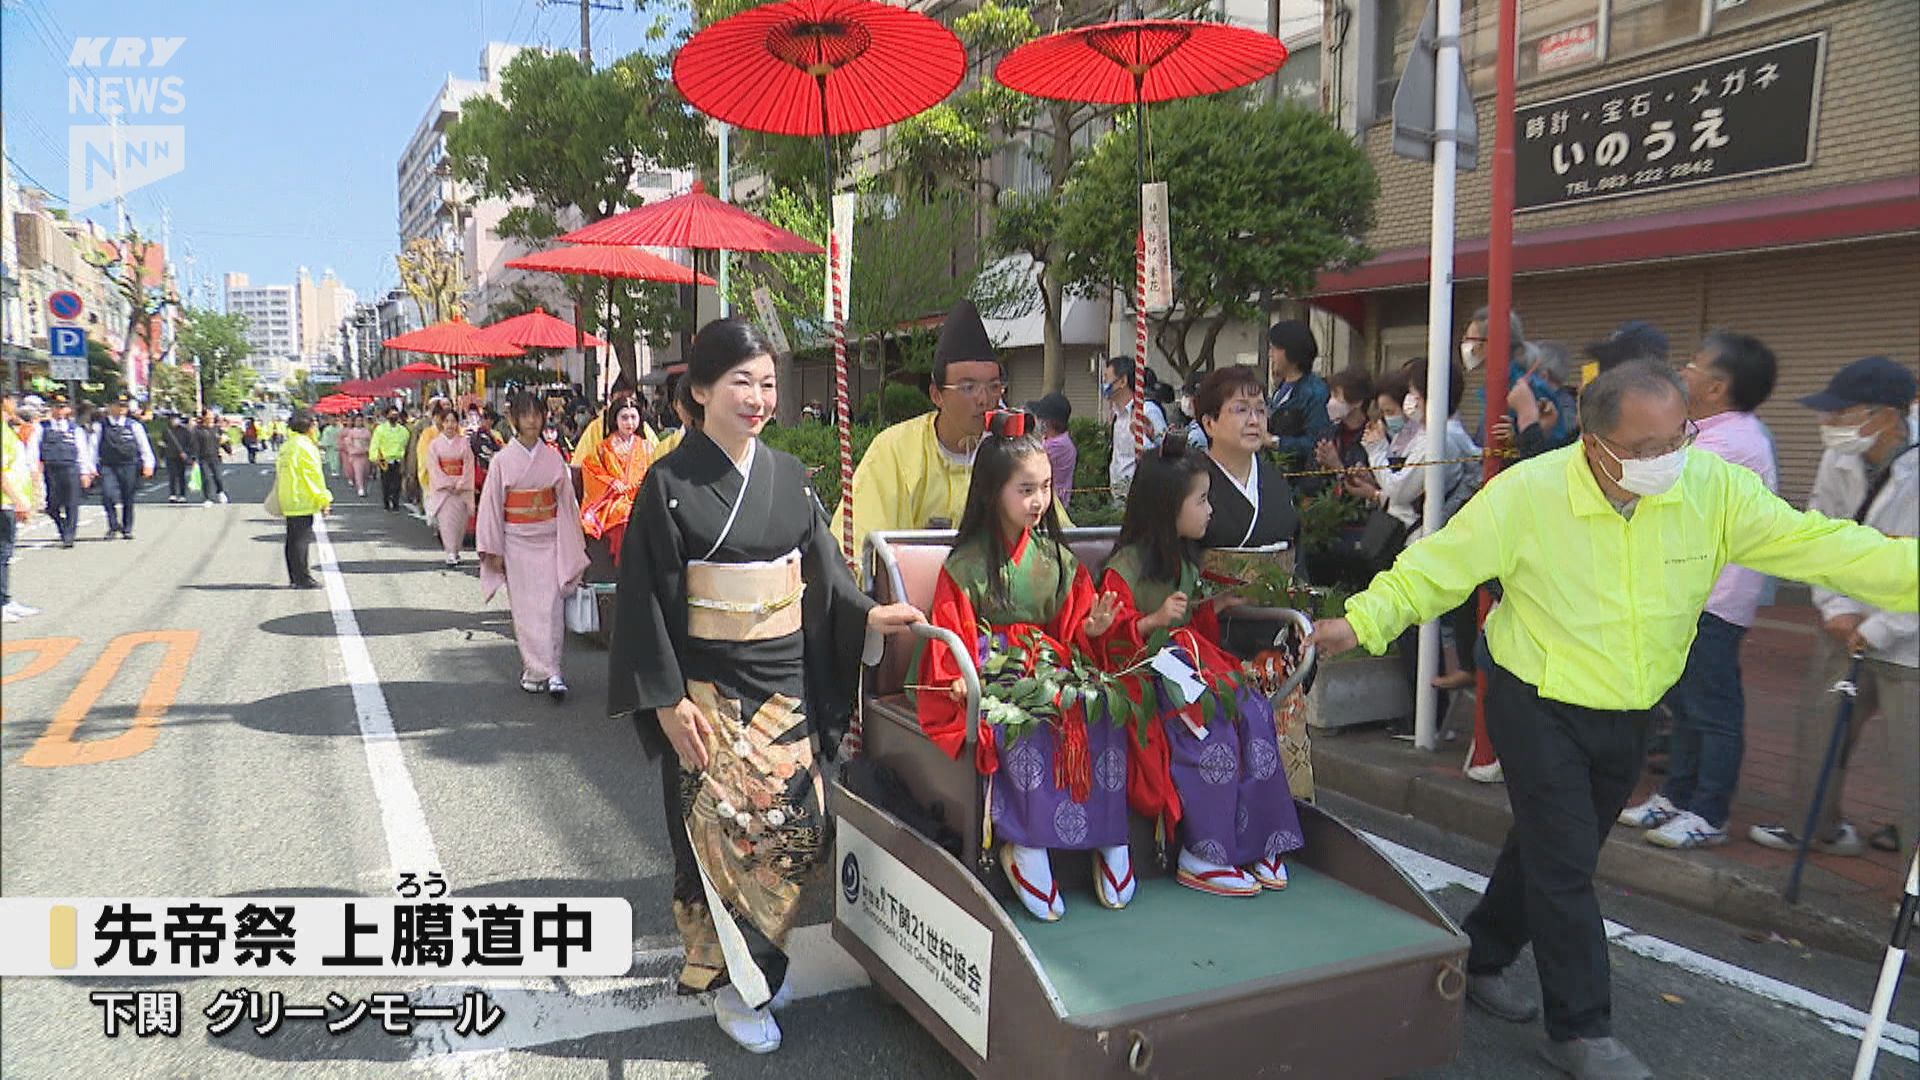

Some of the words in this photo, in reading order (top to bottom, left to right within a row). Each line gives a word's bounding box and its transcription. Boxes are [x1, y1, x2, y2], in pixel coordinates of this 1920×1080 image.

[1524, 62, 1781, 139] 時計・宝石・メガネ
[1552, 106, 1730, 176] いのうえ
[56, 329, 80, 354] P
[887, 892, 982, 997] 下関21世紀協会
